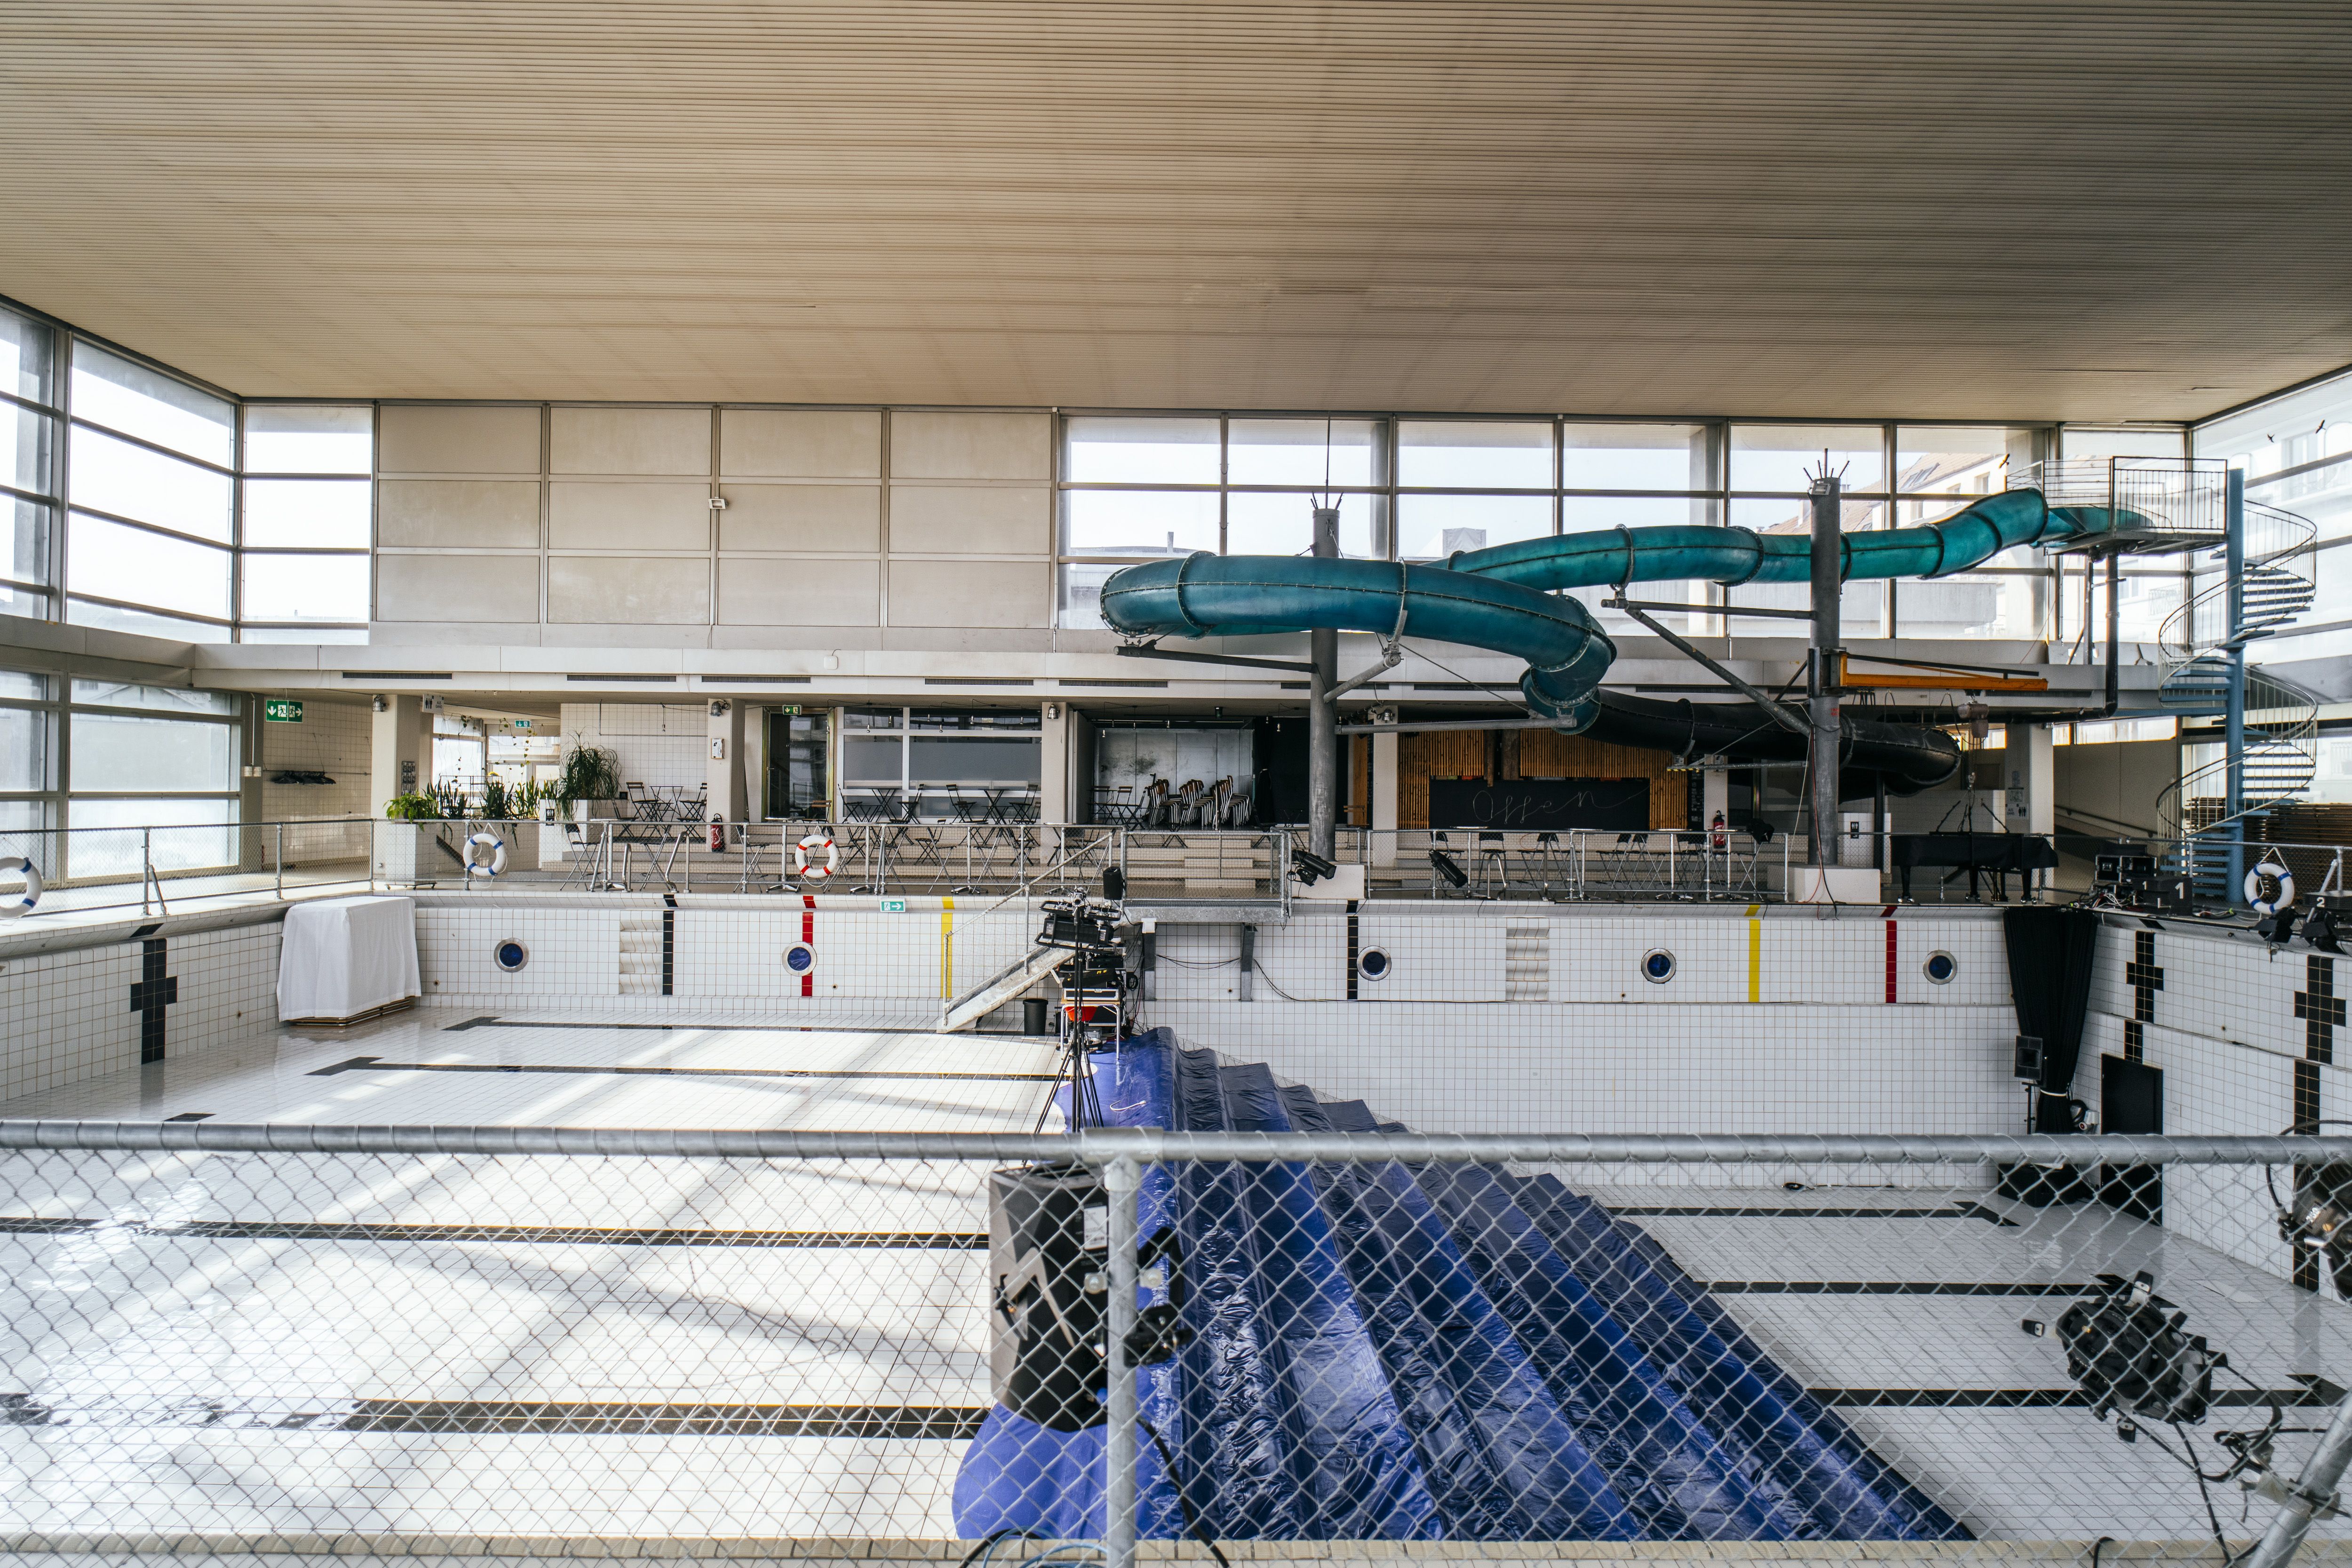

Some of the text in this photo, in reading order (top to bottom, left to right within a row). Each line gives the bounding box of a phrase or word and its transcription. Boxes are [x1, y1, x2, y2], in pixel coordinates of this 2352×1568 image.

[2142, 881, 2147, 890] 1
[2175, 882, 2184, 899] 1
[2316, 897, 2326, 907] 2
